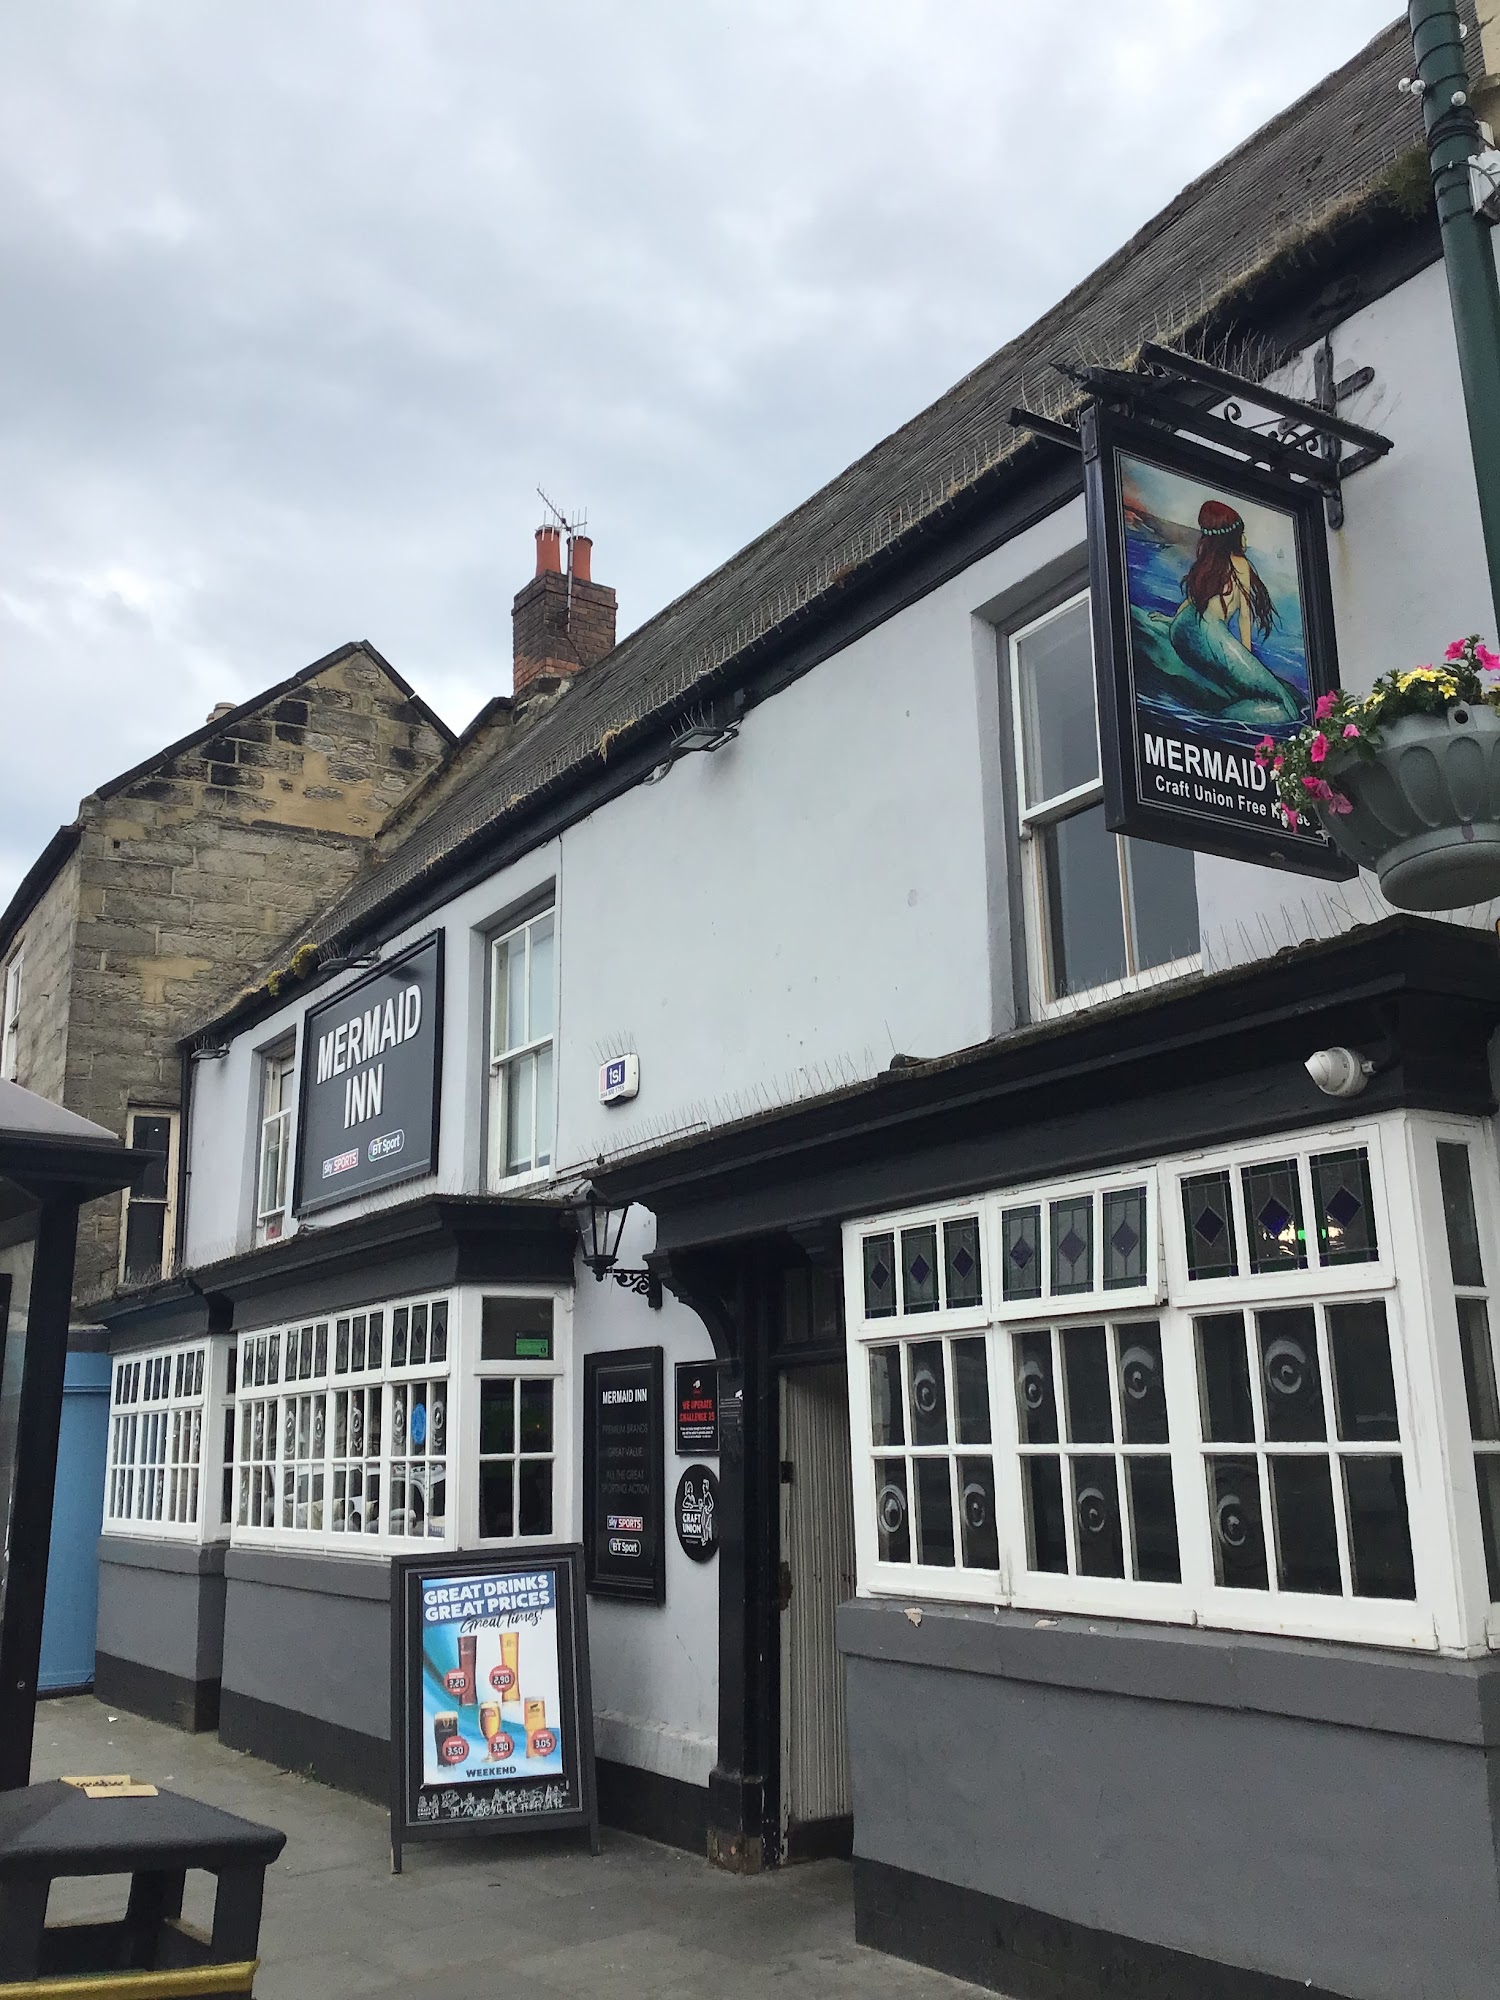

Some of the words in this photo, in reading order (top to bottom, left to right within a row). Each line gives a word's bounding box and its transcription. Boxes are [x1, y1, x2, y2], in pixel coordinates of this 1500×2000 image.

[1144, 732, 1267, 792] MERMAID
[1155, 774, 1190, 799] Craft
[1194, 783, 1234, 809] Union
[1238, 794, 1267, 817] Free
[316, 984, 422, 1085] MERMAID
[343, 1062, 384, 1129] INN
[372, 1142, 382, 1156] BT
[382, 1134, 400, 1153] Sport
[324, 1160, 333, 1174] sky
[333, 1152, 357, 1171] SPORTS
[602, 1389, 634, 1405] MERMAID
[634, 1388, 648, 1402] INN
[608, 1517, 618, 1529] sky
[618, 1518, 641, 1529] SPORTS
[682, 1513, 701, 1523] CRAFT
[682, 1523, 702, 1533] UNION
[612, 1542, 621, 1552] BT
[621, 1542, 637, 1554] Sport
[423, 1583, 482, 1606] GREAT
[484, 1574, 549, 1597] DRINKS
[425, 1599, 484, 1622] GREAT
[487, 1590, 550, 1613] PRICES
[460, 1614, 504, 1634] Great
[506, 1605, 544, 1629] Times!
[535, 1738, 551, 1749] 3.05
[465, 1766, 517, 1778] WEEKEND
